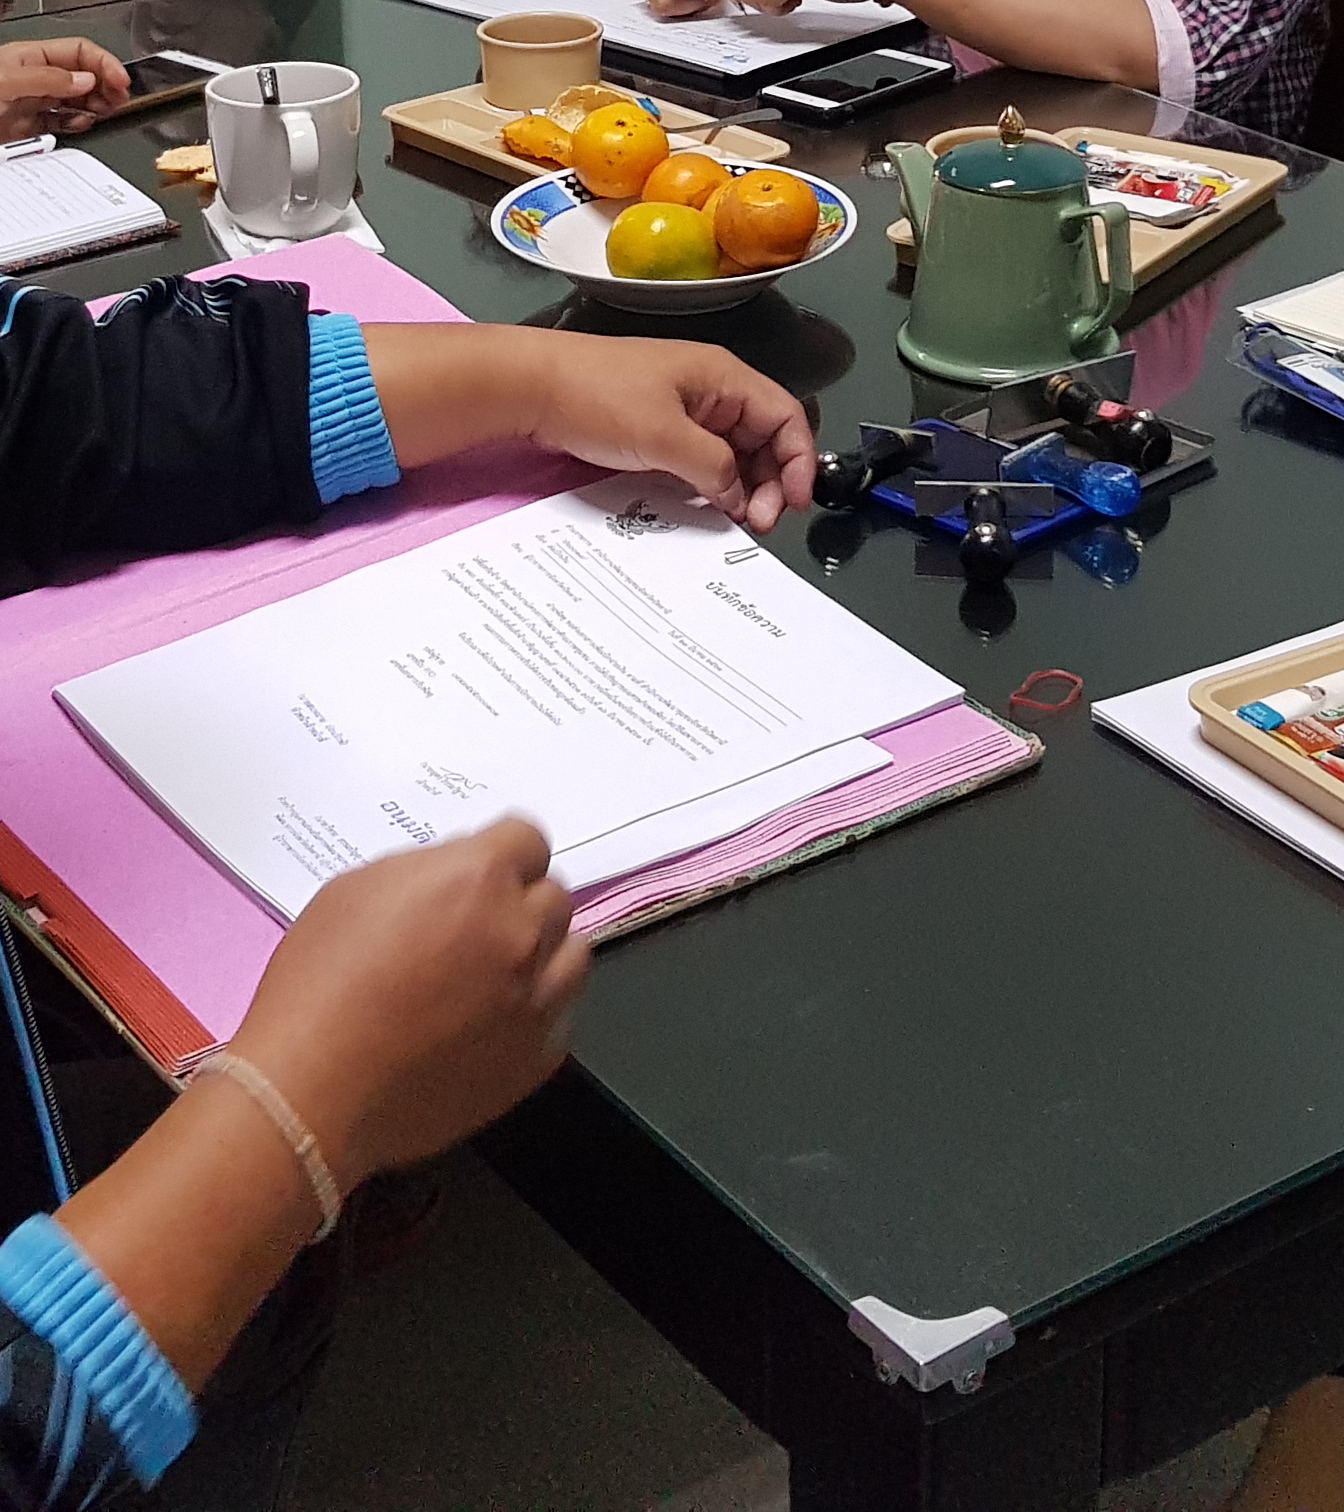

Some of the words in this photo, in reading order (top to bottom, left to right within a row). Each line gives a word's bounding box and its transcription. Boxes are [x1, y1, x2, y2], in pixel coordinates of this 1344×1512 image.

[704, 580, 786, 638] บันทึกข้อความ
[379, 800, 436, 844] อนุมัติ
